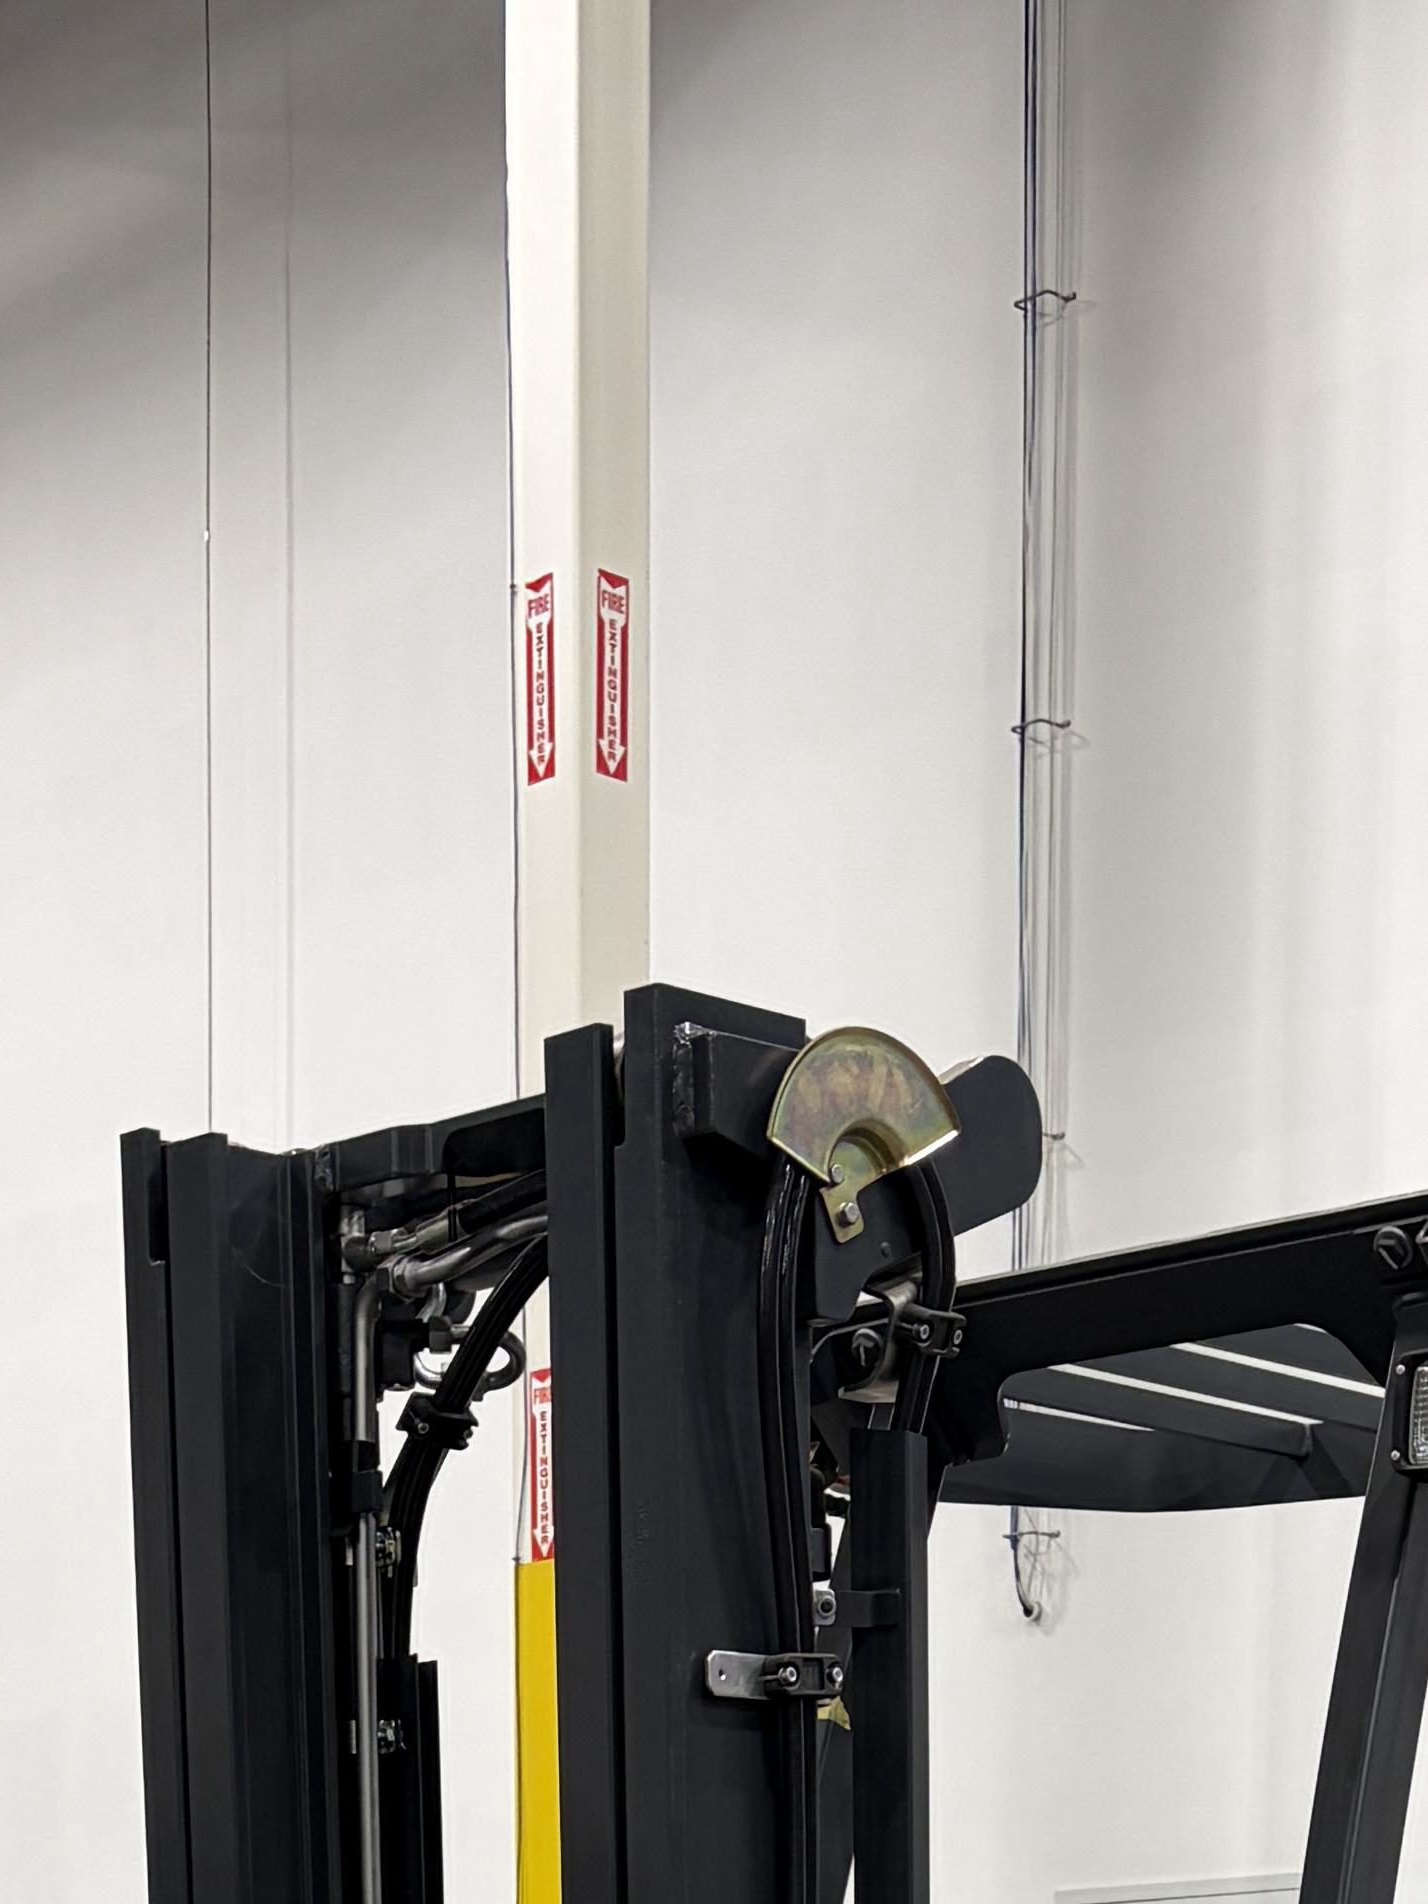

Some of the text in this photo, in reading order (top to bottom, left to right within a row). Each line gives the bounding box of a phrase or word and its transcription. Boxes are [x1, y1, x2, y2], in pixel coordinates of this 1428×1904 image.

[528, 593, 551, 617] FIRE
[602, 590, 625, 614] FIRE
[535, 622, 546, 764] EXTINGUISHER
[607, 619, 618, 762] EXTINGUISHER
[540, 1411, 549, 1544] EXTINGUISHER
